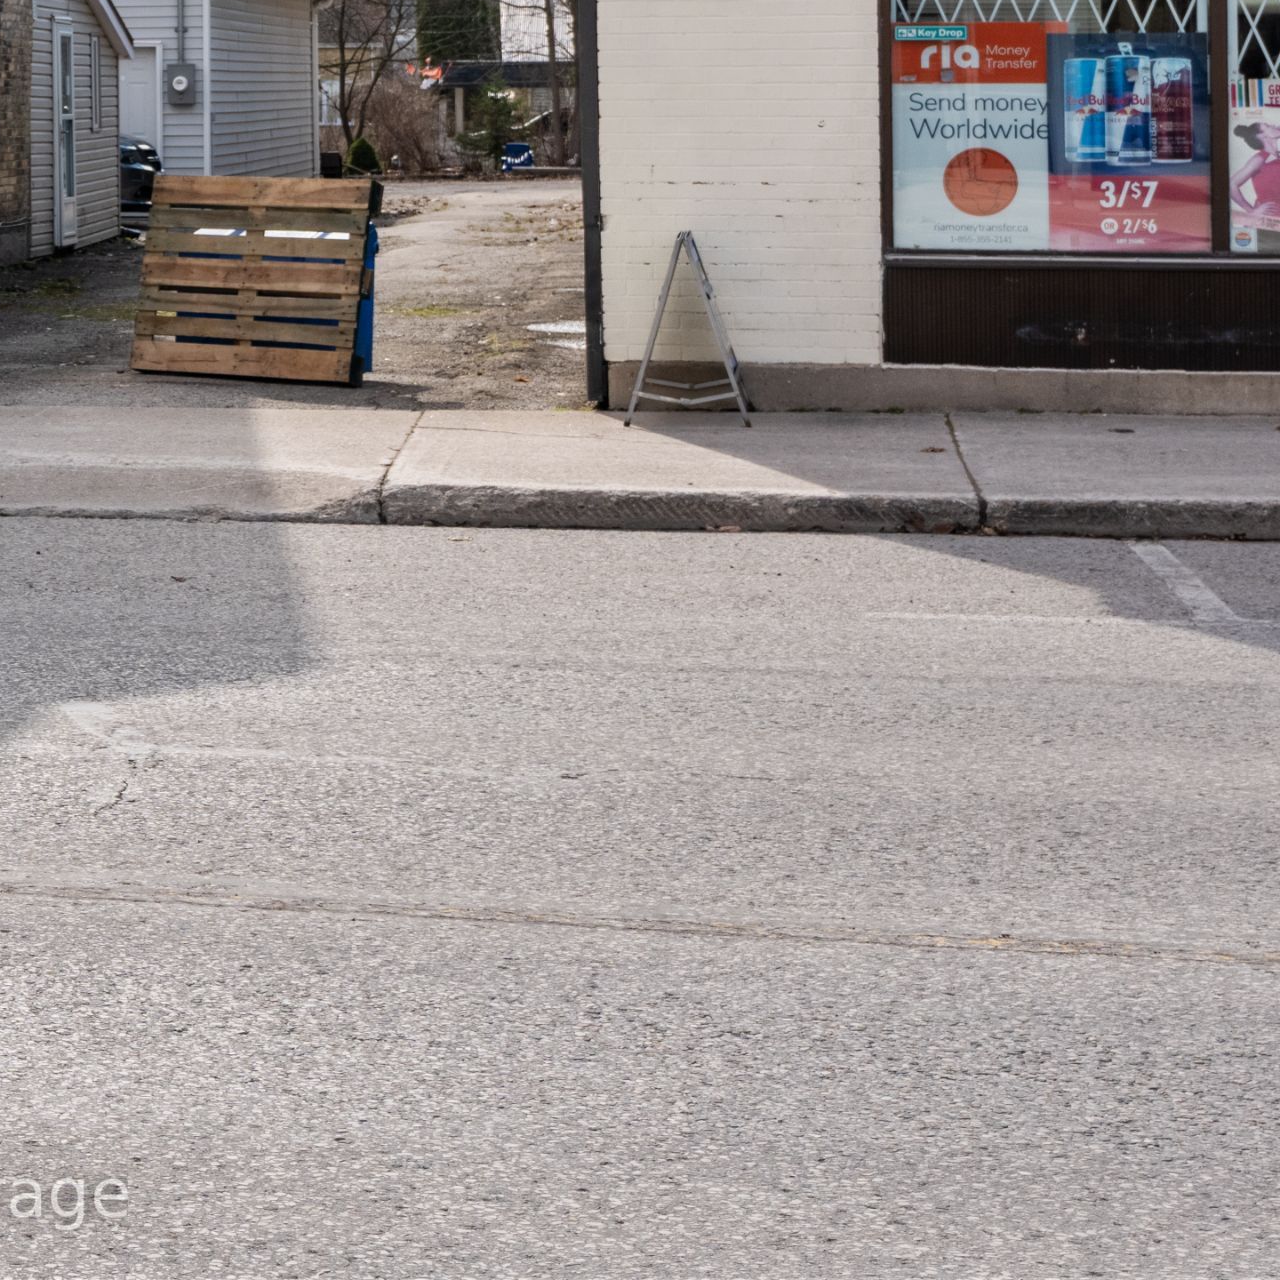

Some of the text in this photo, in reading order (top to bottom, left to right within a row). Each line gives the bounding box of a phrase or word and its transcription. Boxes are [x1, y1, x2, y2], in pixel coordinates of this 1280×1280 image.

[918, 29, 963, 39] Key Drop
[920, 41, 1030, 69] ria Money
[986, 58, 1037, 69] Transfer
[909, 93, 1048, 115] Send money
[910, 118, 1048, 140] Worldwide
[1100, 181, 1158, 208] 3/$7
[1123, 218, 1157, 234] 2/$6
